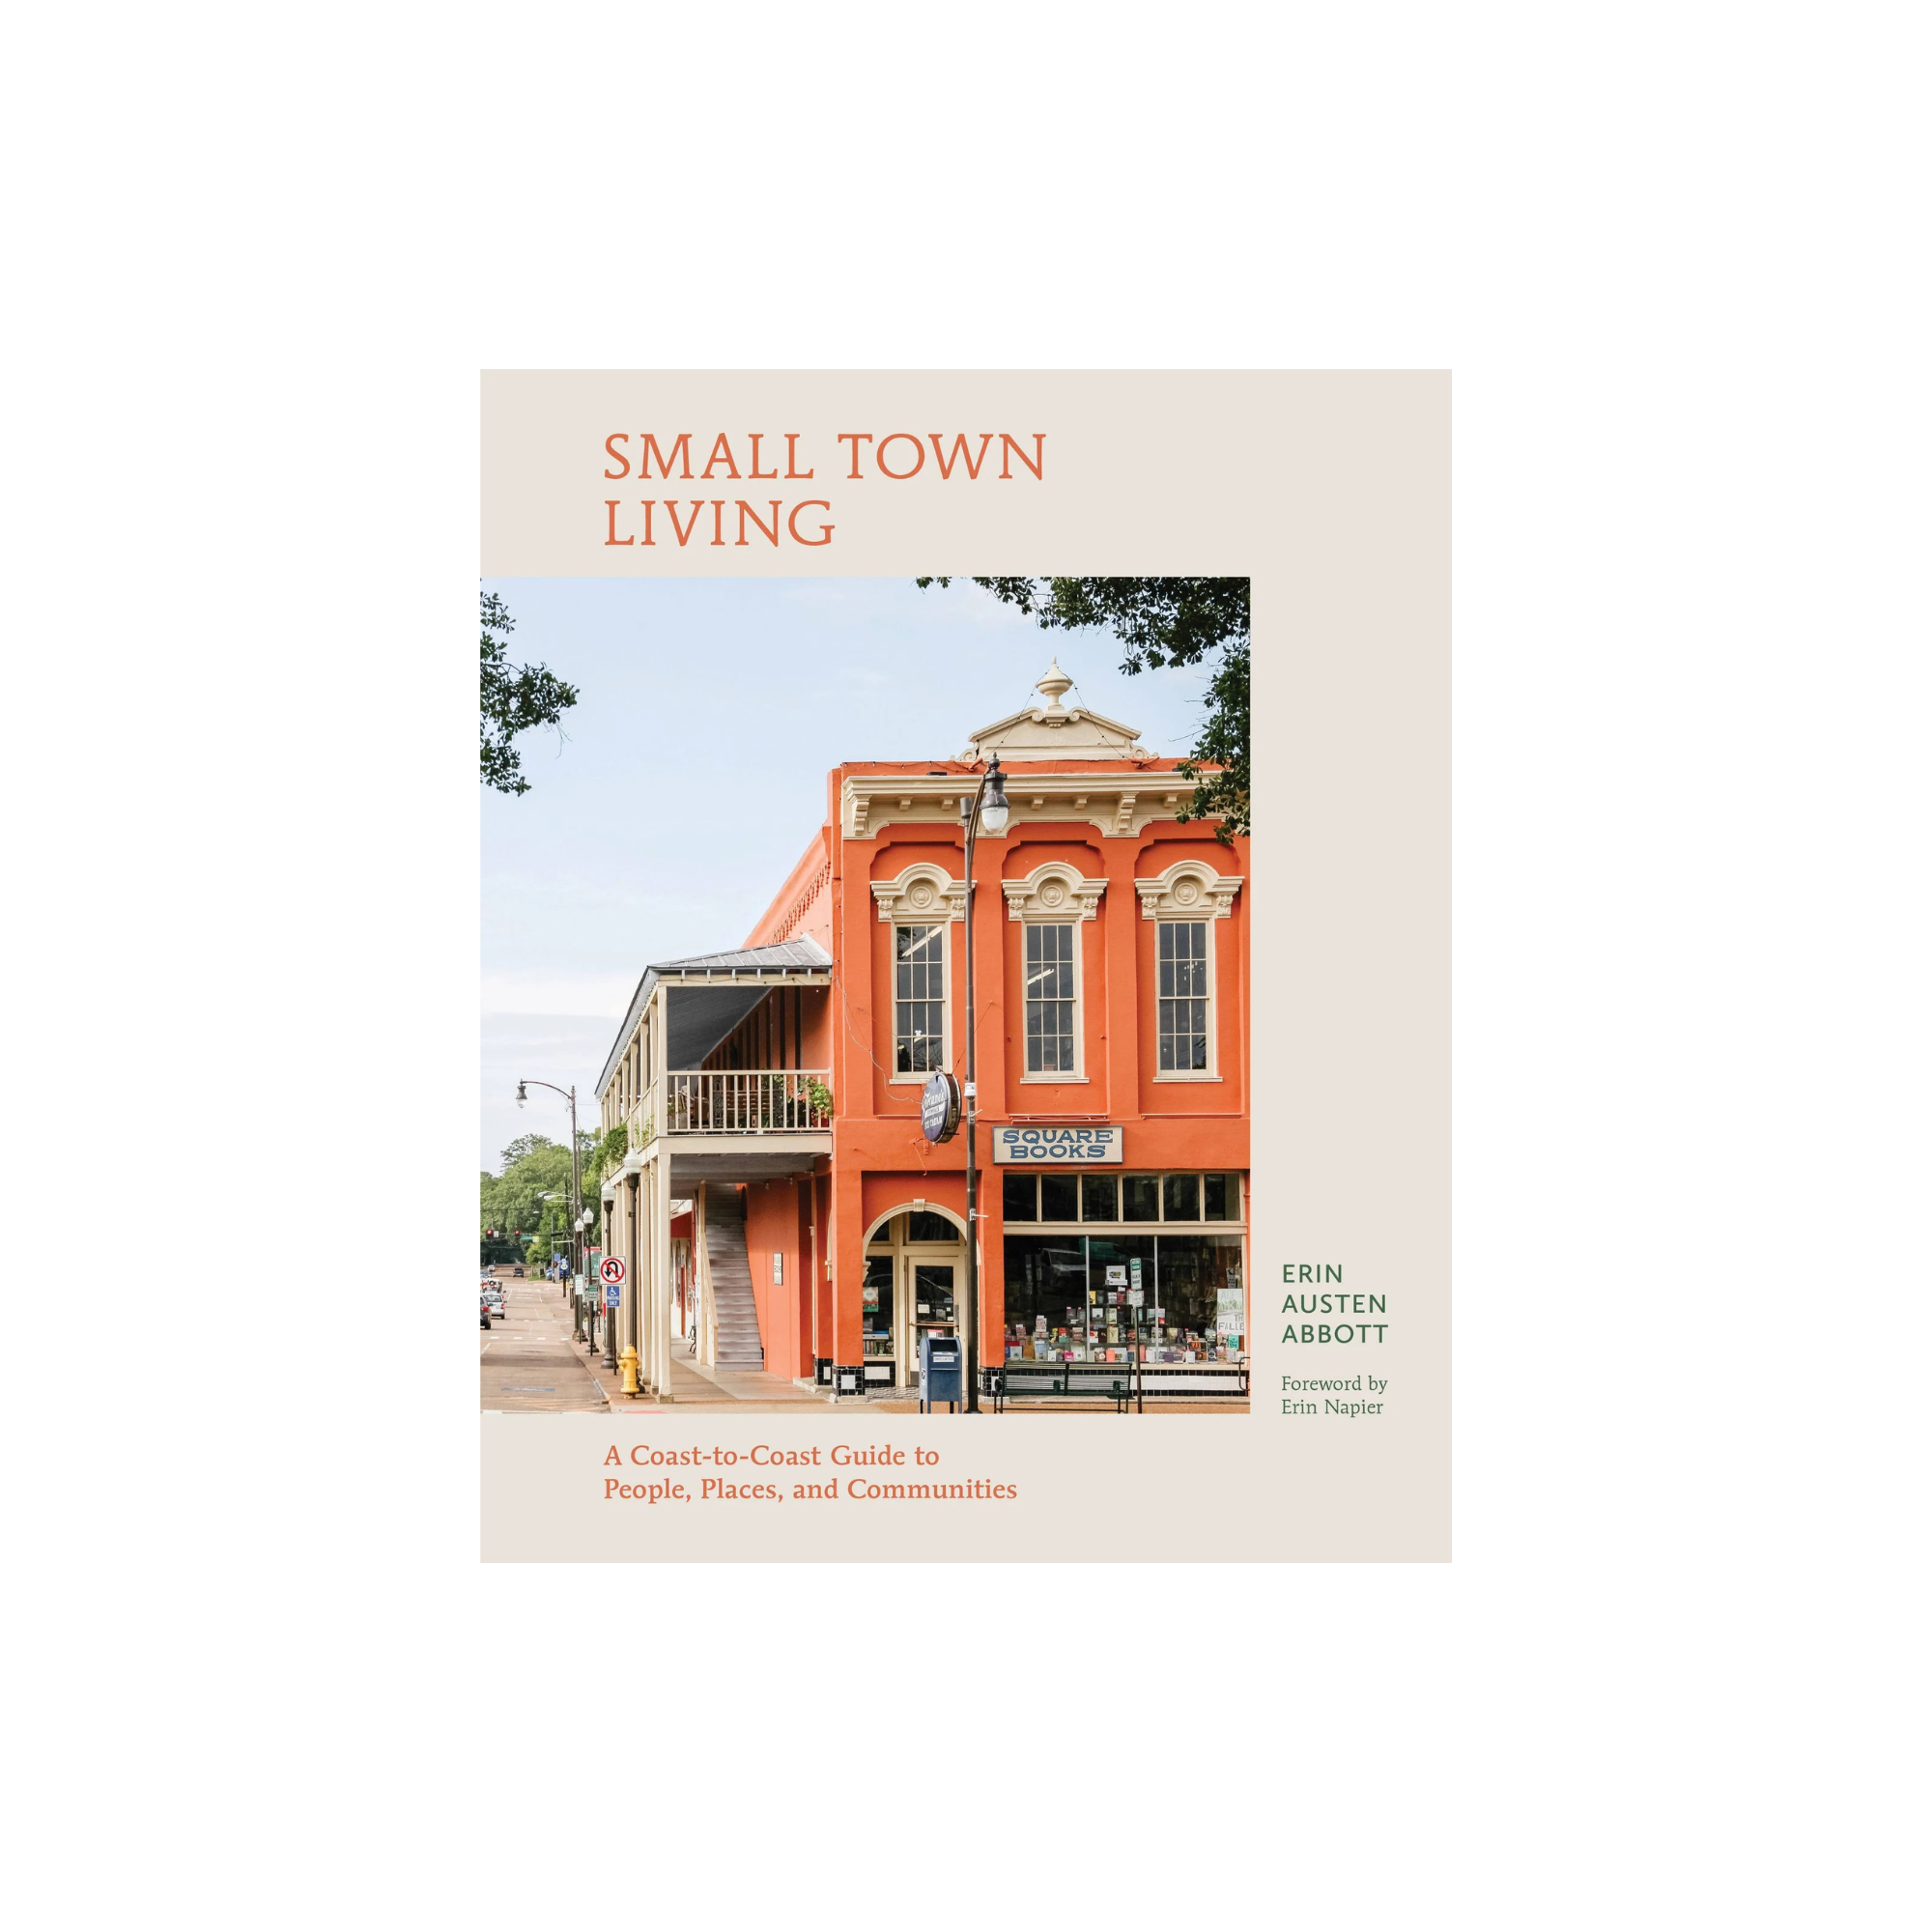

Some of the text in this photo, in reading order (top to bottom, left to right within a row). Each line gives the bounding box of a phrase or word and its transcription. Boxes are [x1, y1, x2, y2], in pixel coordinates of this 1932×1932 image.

[605, 433, 1046, 481] SMALL TOWN
[605, 499, 836, 548] LIVING
[1003, 1129, 1114, 1145] SQUARE
[1009, 1145, 1106, 1158] BOOKS
[1283, 1264, 1342, 1283] ERIN
[1282, 1293, 1385, 1314] AUSTEN
[1218, 1321, 1244, 1331] FALLE
[1282, 1324, 1388, 1344] ABBOTT
[1282, 1375, 1388, 1395] Foreword by
[1282, 1399, 1383, 1418] Erin Napier
[604, 1444, 939, 1465] A Coast-to-Coast Guide to
[605, 1478, 1017, 1504] People, Places, and Communities
